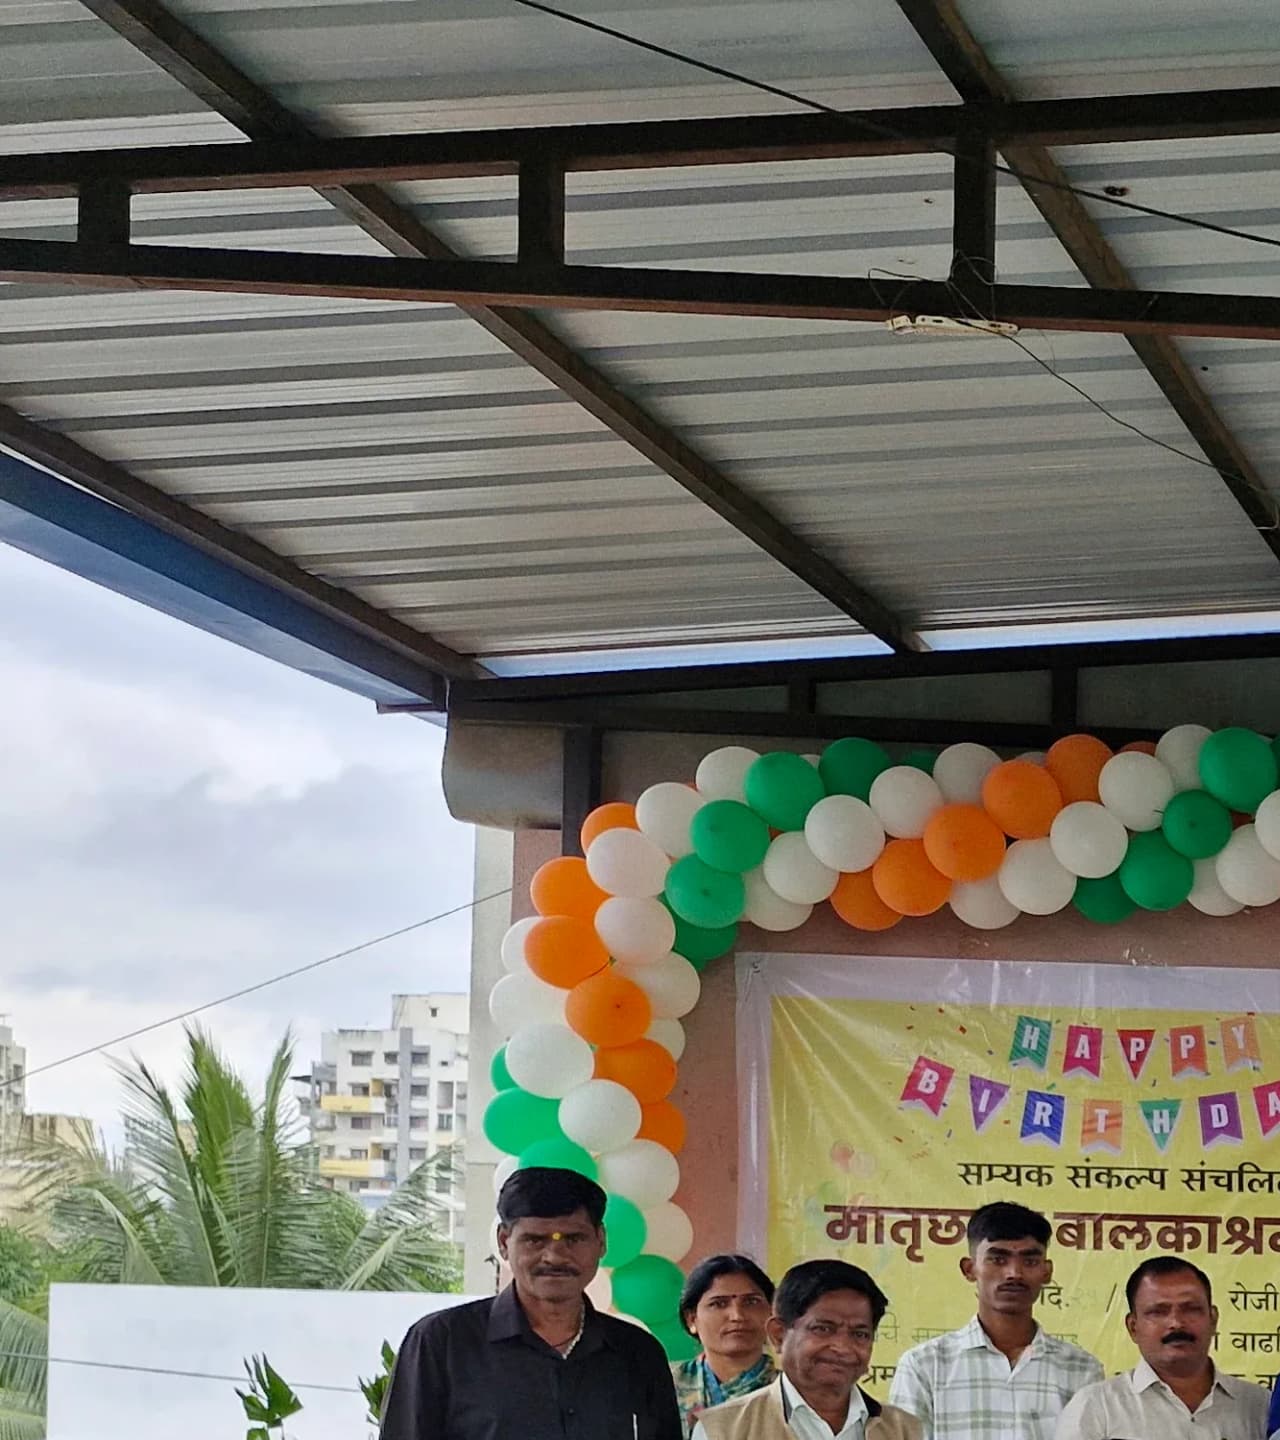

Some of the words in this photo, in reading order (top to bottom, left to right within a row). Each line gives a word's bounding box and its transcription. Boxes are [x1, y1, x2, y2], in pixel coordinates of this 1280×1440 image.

[1022, 1023, 1247, 1061] HAPPY
[957, 1162, 1055, 1189] सम्यक
[1066, 1157, 1169, 1192] संकल्प
[1228, 1281, 1280, 1312] रोजी
